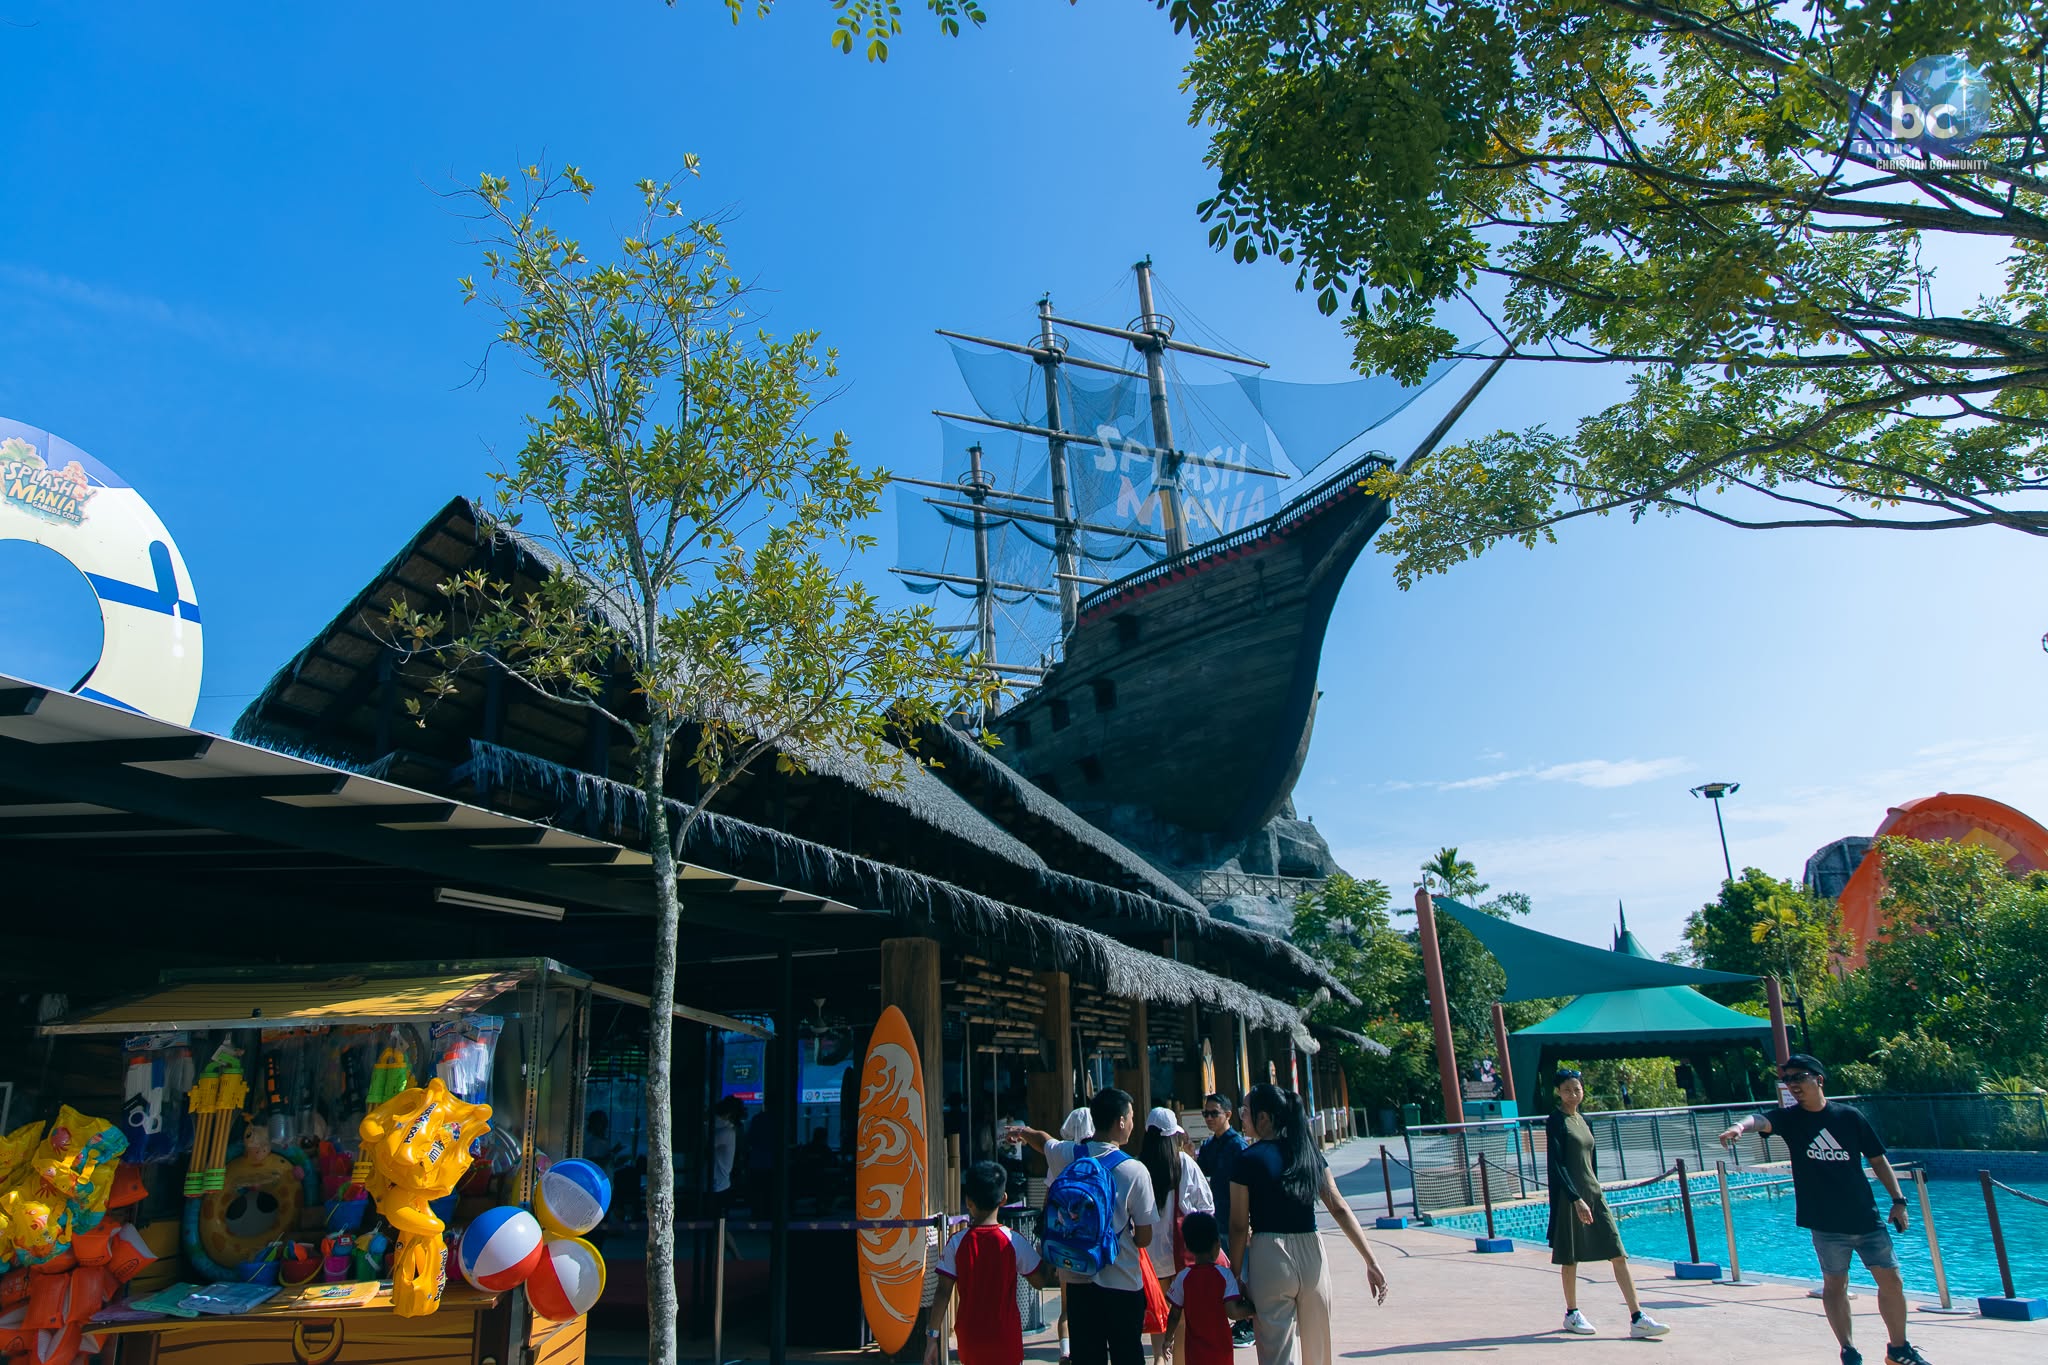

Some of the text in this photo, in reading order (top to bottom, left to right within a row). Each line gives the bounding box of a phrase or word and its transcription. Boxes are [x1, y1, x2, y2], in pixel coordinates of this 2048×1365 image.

[1093, 424, 1248, 495] SPLASH
[5, 461, 75, 497] SPLASH
[8, 478, 77, 513] MANIA
[32, 500, 81, 523] GAMUDA COVE
[1116, 474, 1265, 532] MANIA
[1806, 1149, 1850, 1161] adidas
